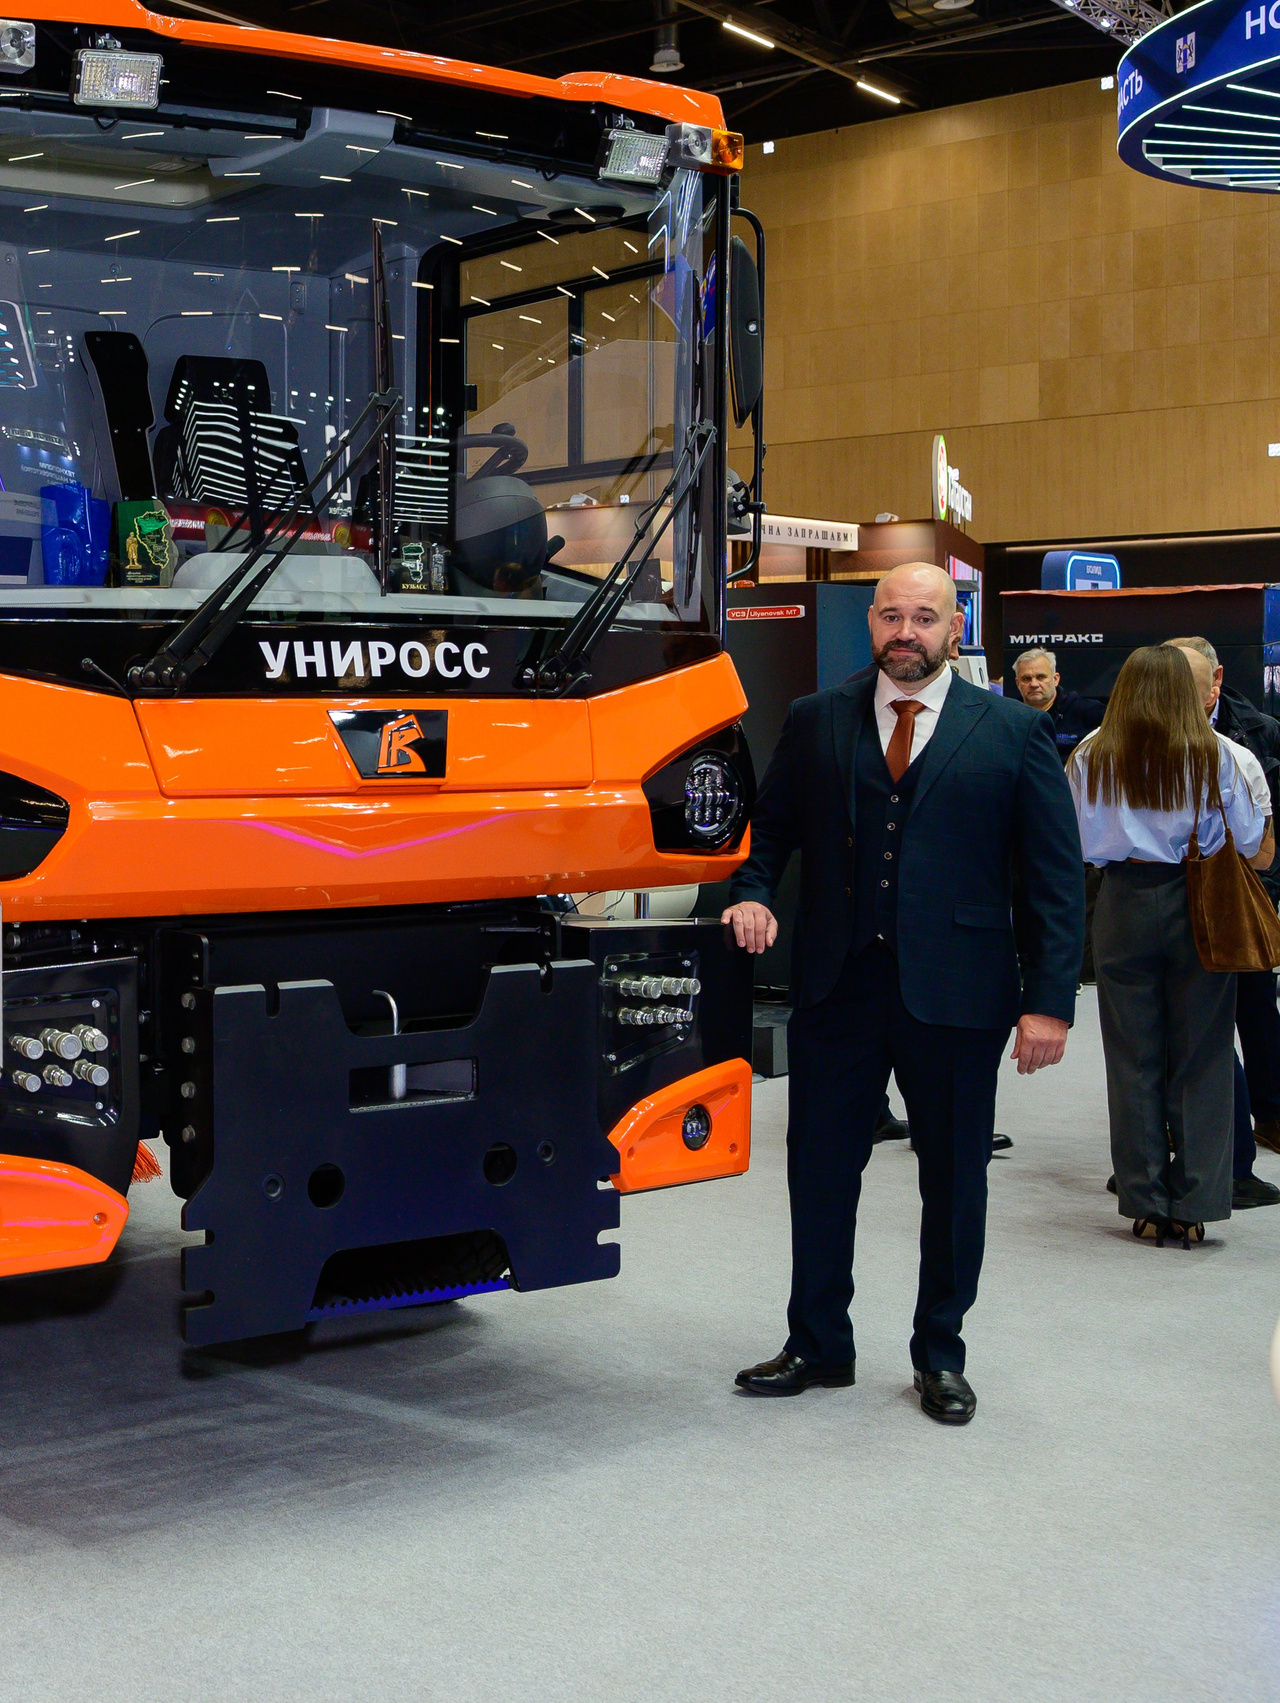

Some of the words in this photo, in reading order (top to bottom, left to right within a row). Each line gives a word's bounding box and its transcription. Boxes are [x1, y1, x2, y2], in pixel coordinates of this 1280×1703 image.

[1118, 69, 1143, 120] АСТЬ
[787, 527, 853, 542] ЗАПРАШАЕМ!
[1009, 633, 1104, 645] МИТРАКС
[258, 641, 491, 679] УНИРОСС
